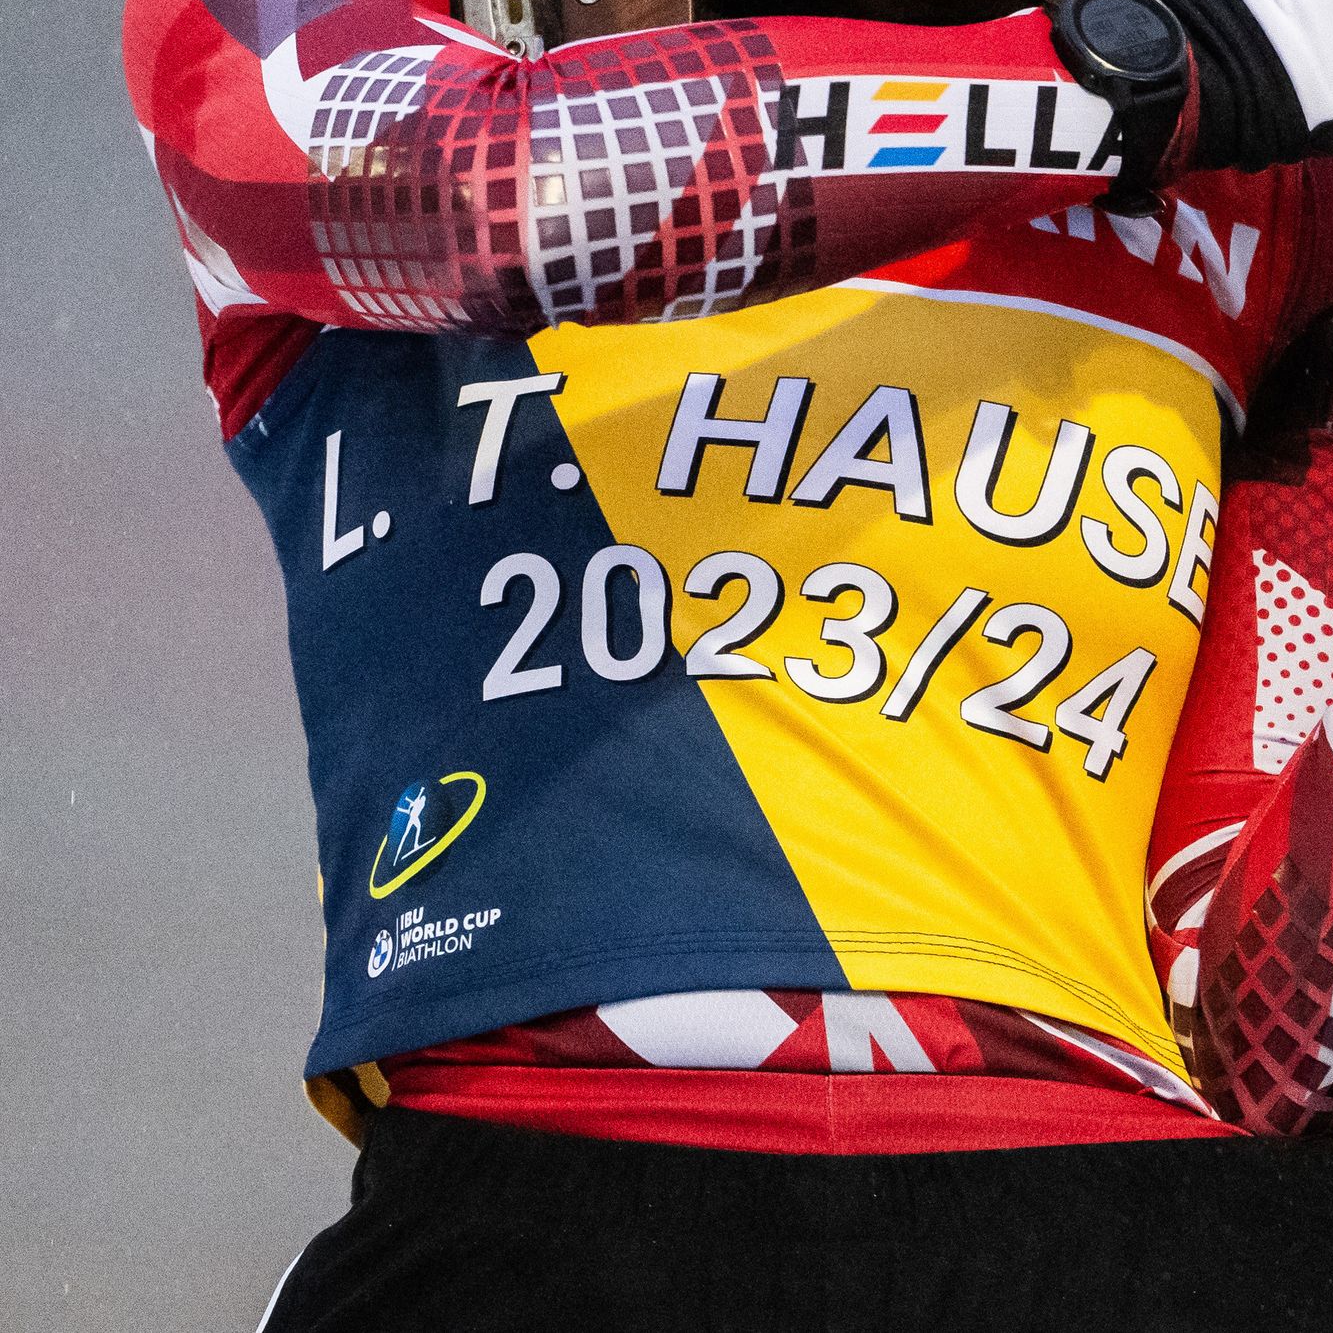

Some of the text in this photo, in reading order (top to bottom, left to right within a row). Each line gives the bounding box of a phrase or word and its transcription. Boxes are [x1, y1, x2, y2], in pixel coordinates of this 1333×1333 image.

[322, 430, 393, 571] L.
[456, 372, 583, 508] T.
[480, 543, 1157, 783] 2023/24
[400, 906, 425, 931] IBU
[400, 907, 502, 949] WORLD CUP
[397, 932, 473, 970] BIATHLON
